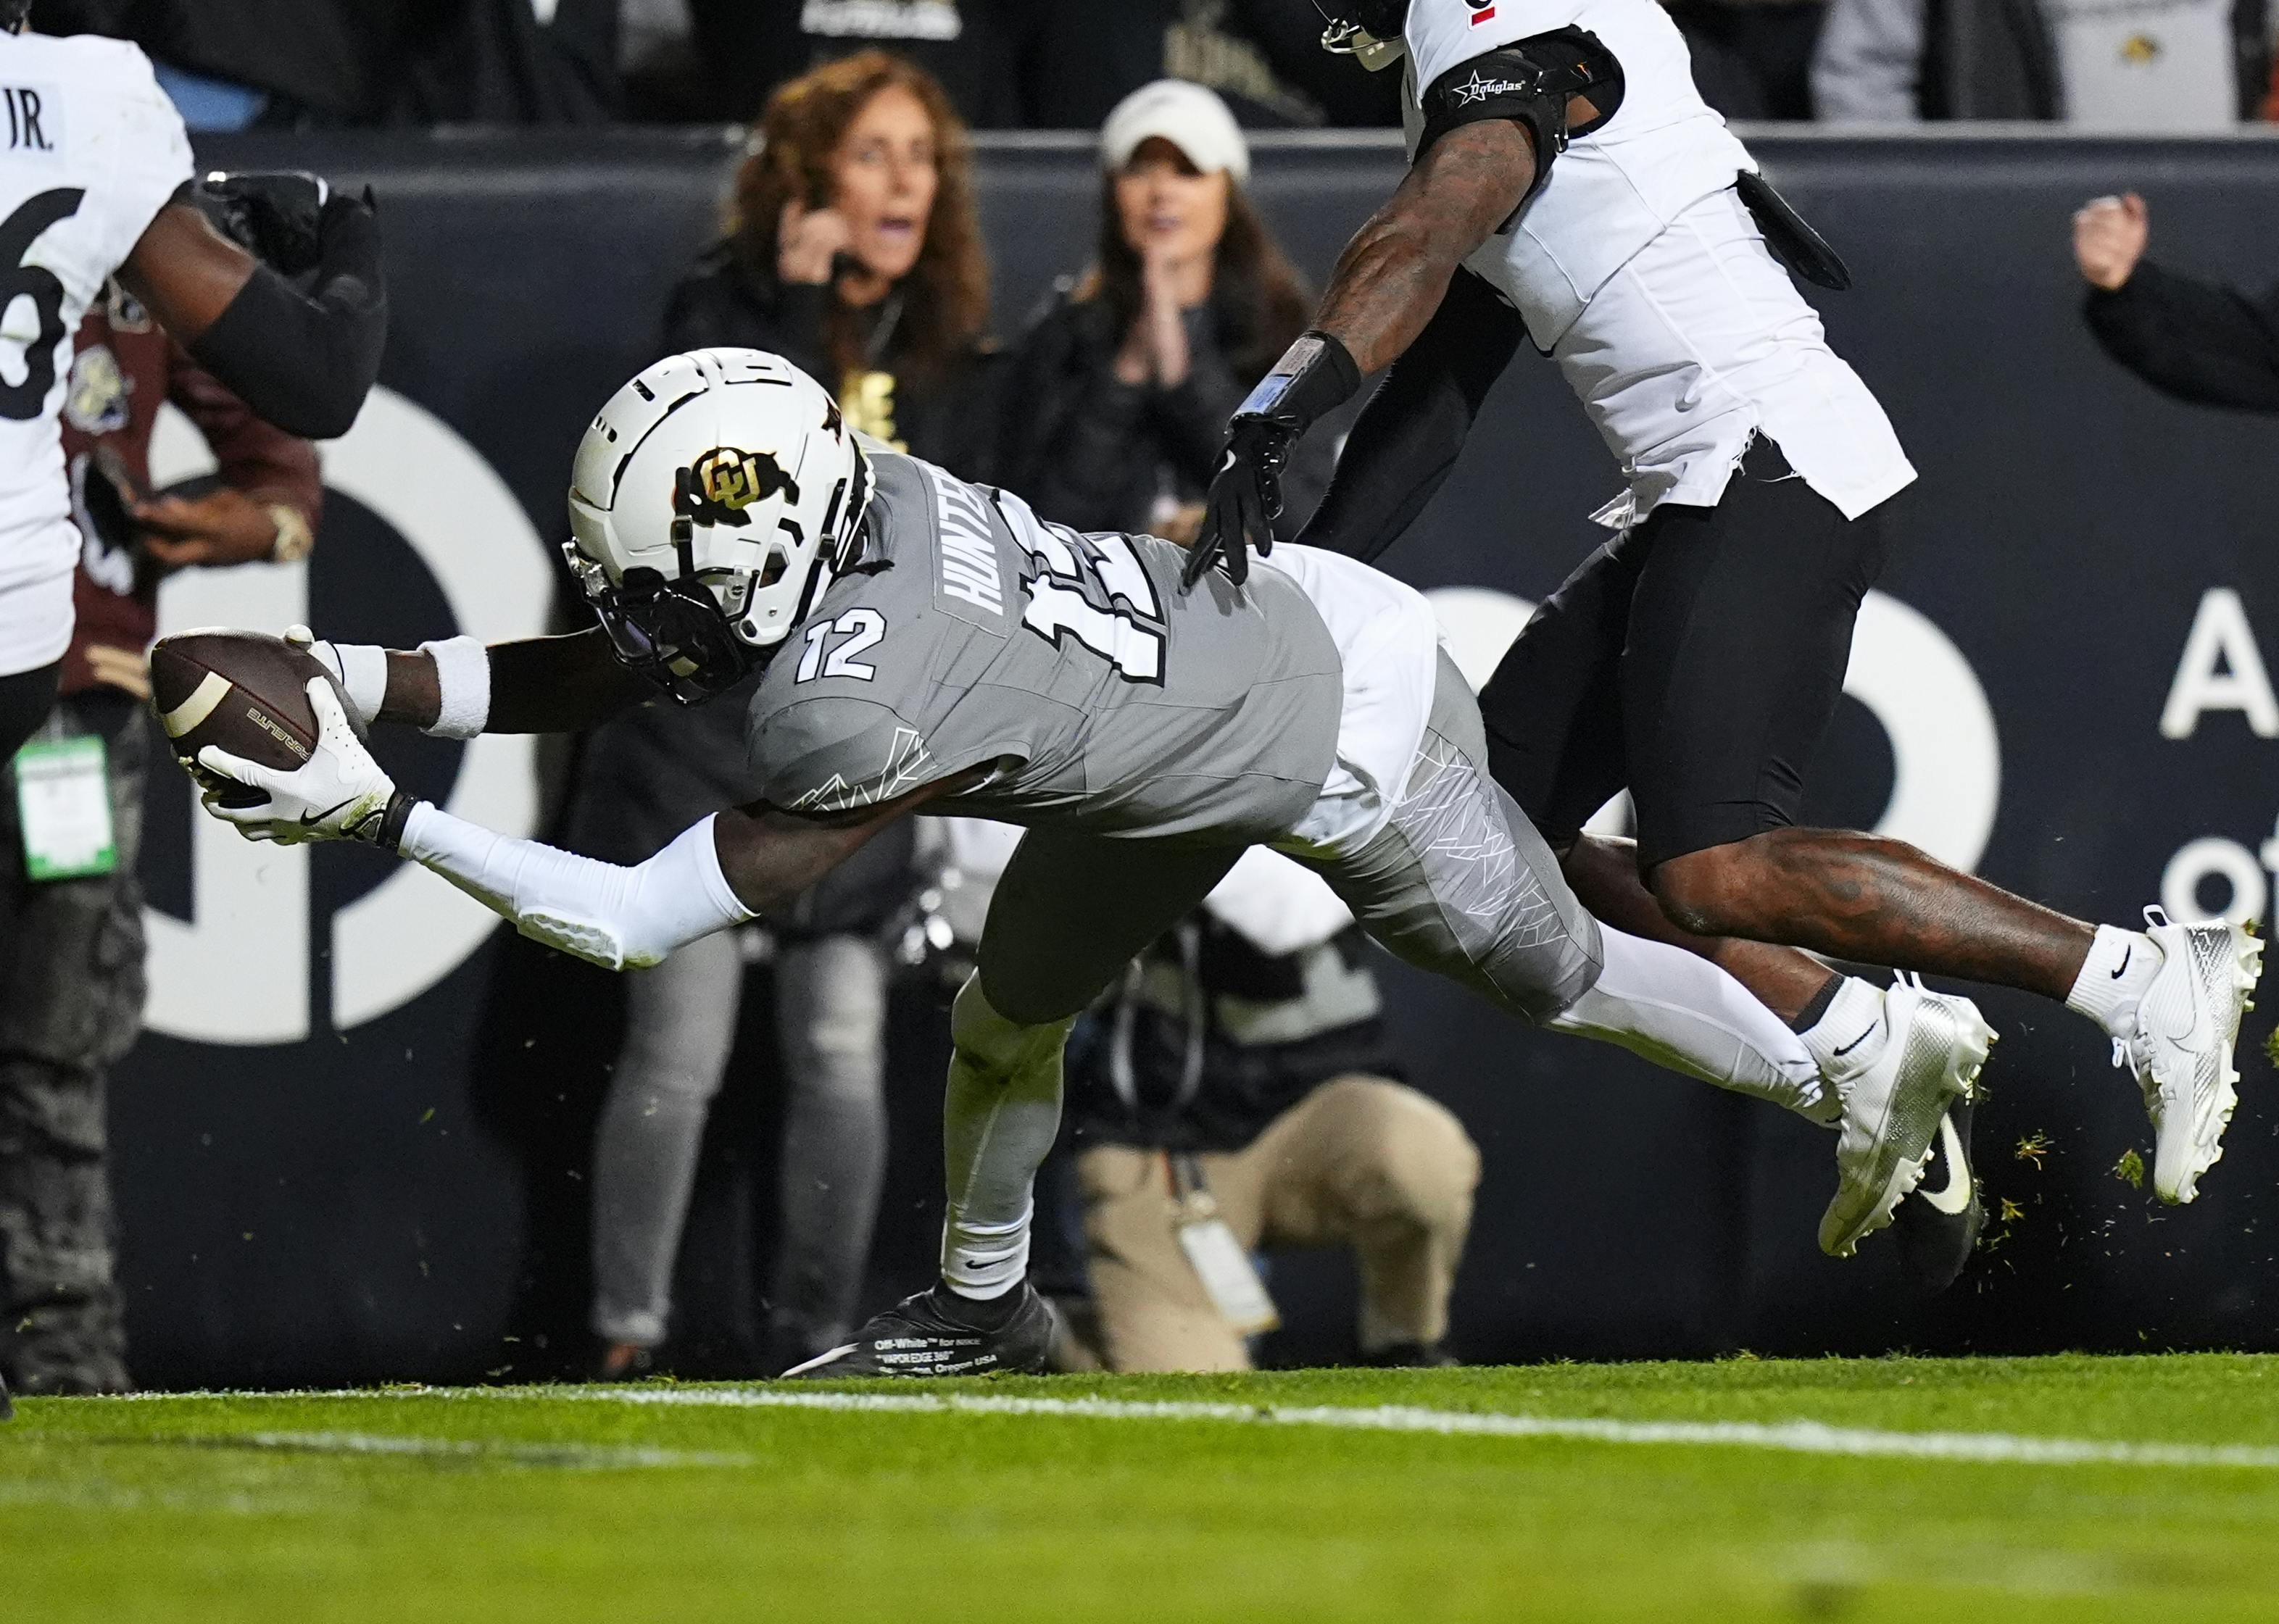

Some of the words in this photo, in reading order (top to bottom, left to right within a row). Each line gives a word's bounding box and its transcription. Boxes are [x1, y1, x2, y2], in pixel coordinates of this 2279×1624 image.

[2, 87, 54, 149] JR.
[794, 607, 887, 685] 12
[974, 1354, 997, 1366] USA
